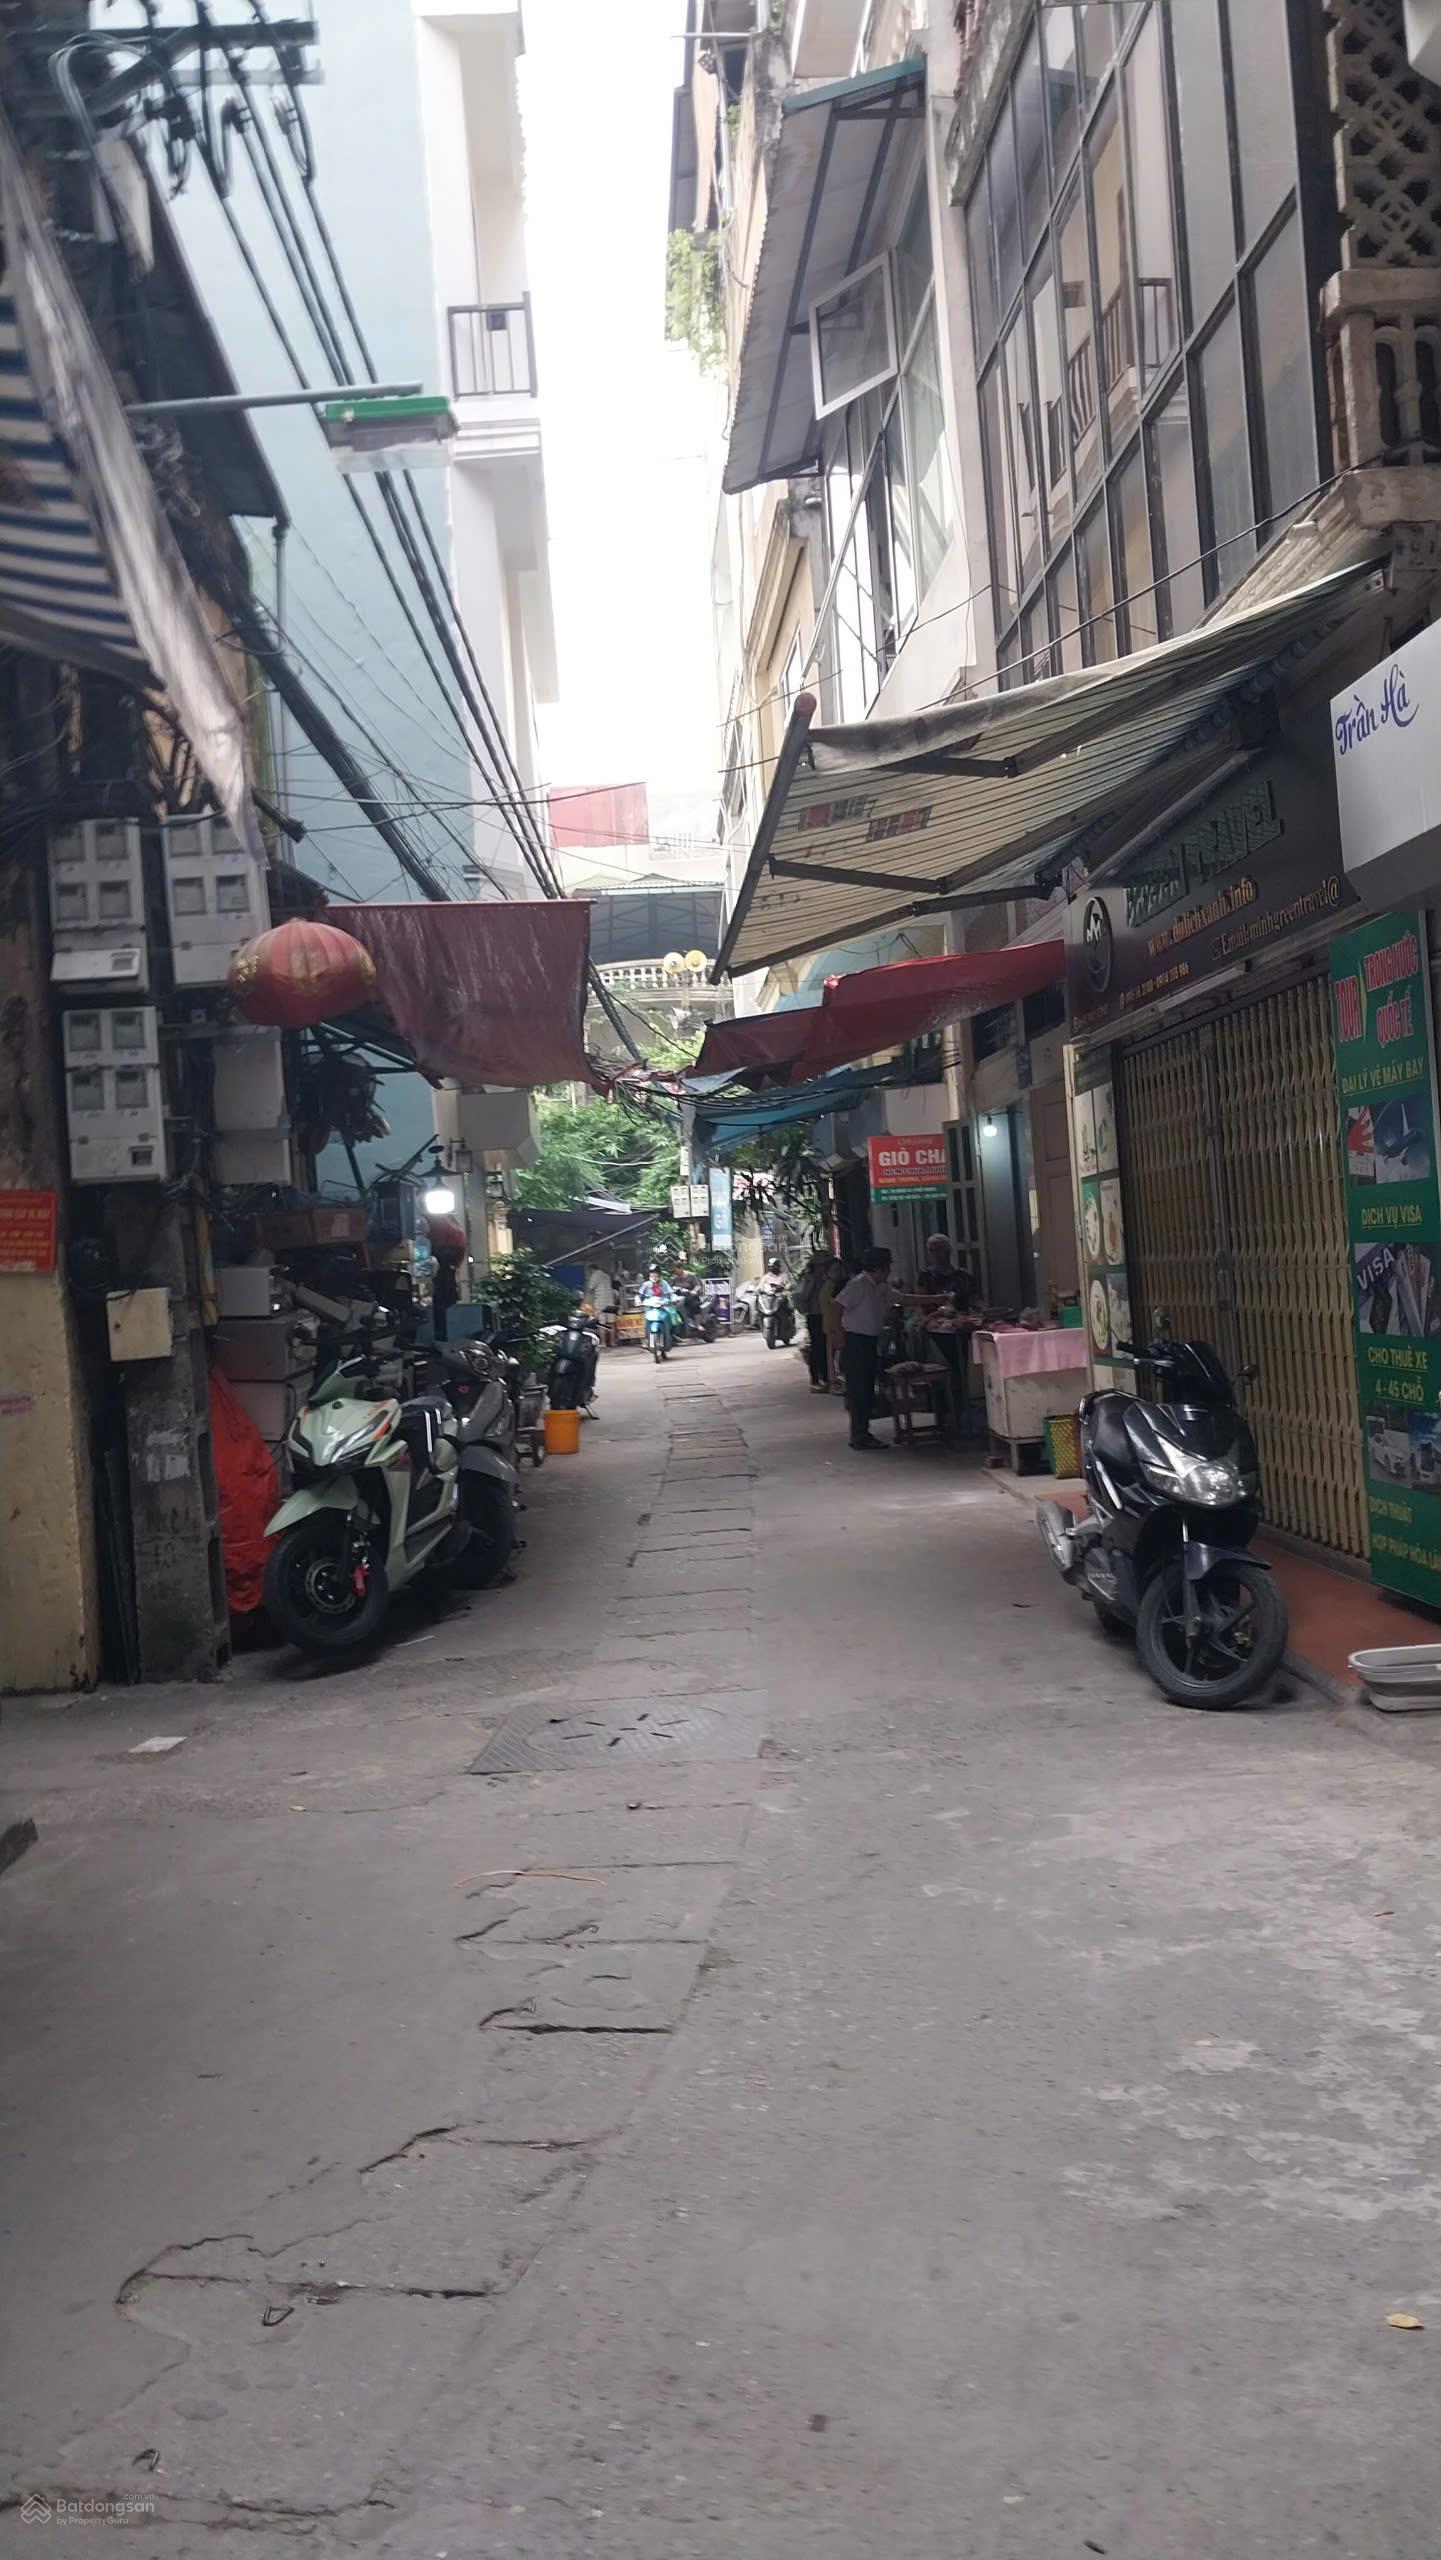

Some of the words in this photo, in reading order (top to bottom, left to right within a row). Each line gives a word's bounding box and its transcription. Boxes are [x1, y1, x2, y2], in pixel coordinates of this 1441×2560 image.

[1336, 694, 1379, 755] Trần
[1381, 664, 1419, 728] Hà
[1364, 946, 1393, 992] TRONG
[1334, 975, 1362, 1043] TOUR
[1376, 990, 1400, 1048] QUỐC
[1382, 1058, 1403, 1085] MÁY
[1405, 1056, 1424, 1079] BAY
[878, 1147, 910, 1166] GIÒ
[1361, 1207, 1384, 1230] DỊCH
[1400, 1204, 1423, 1224] VISA
[1356, 1247, 1395, 1290] VISA
[1368, 1346, 1389, 1365] CHO
[1414, 1351, 1428, 1370] XE
